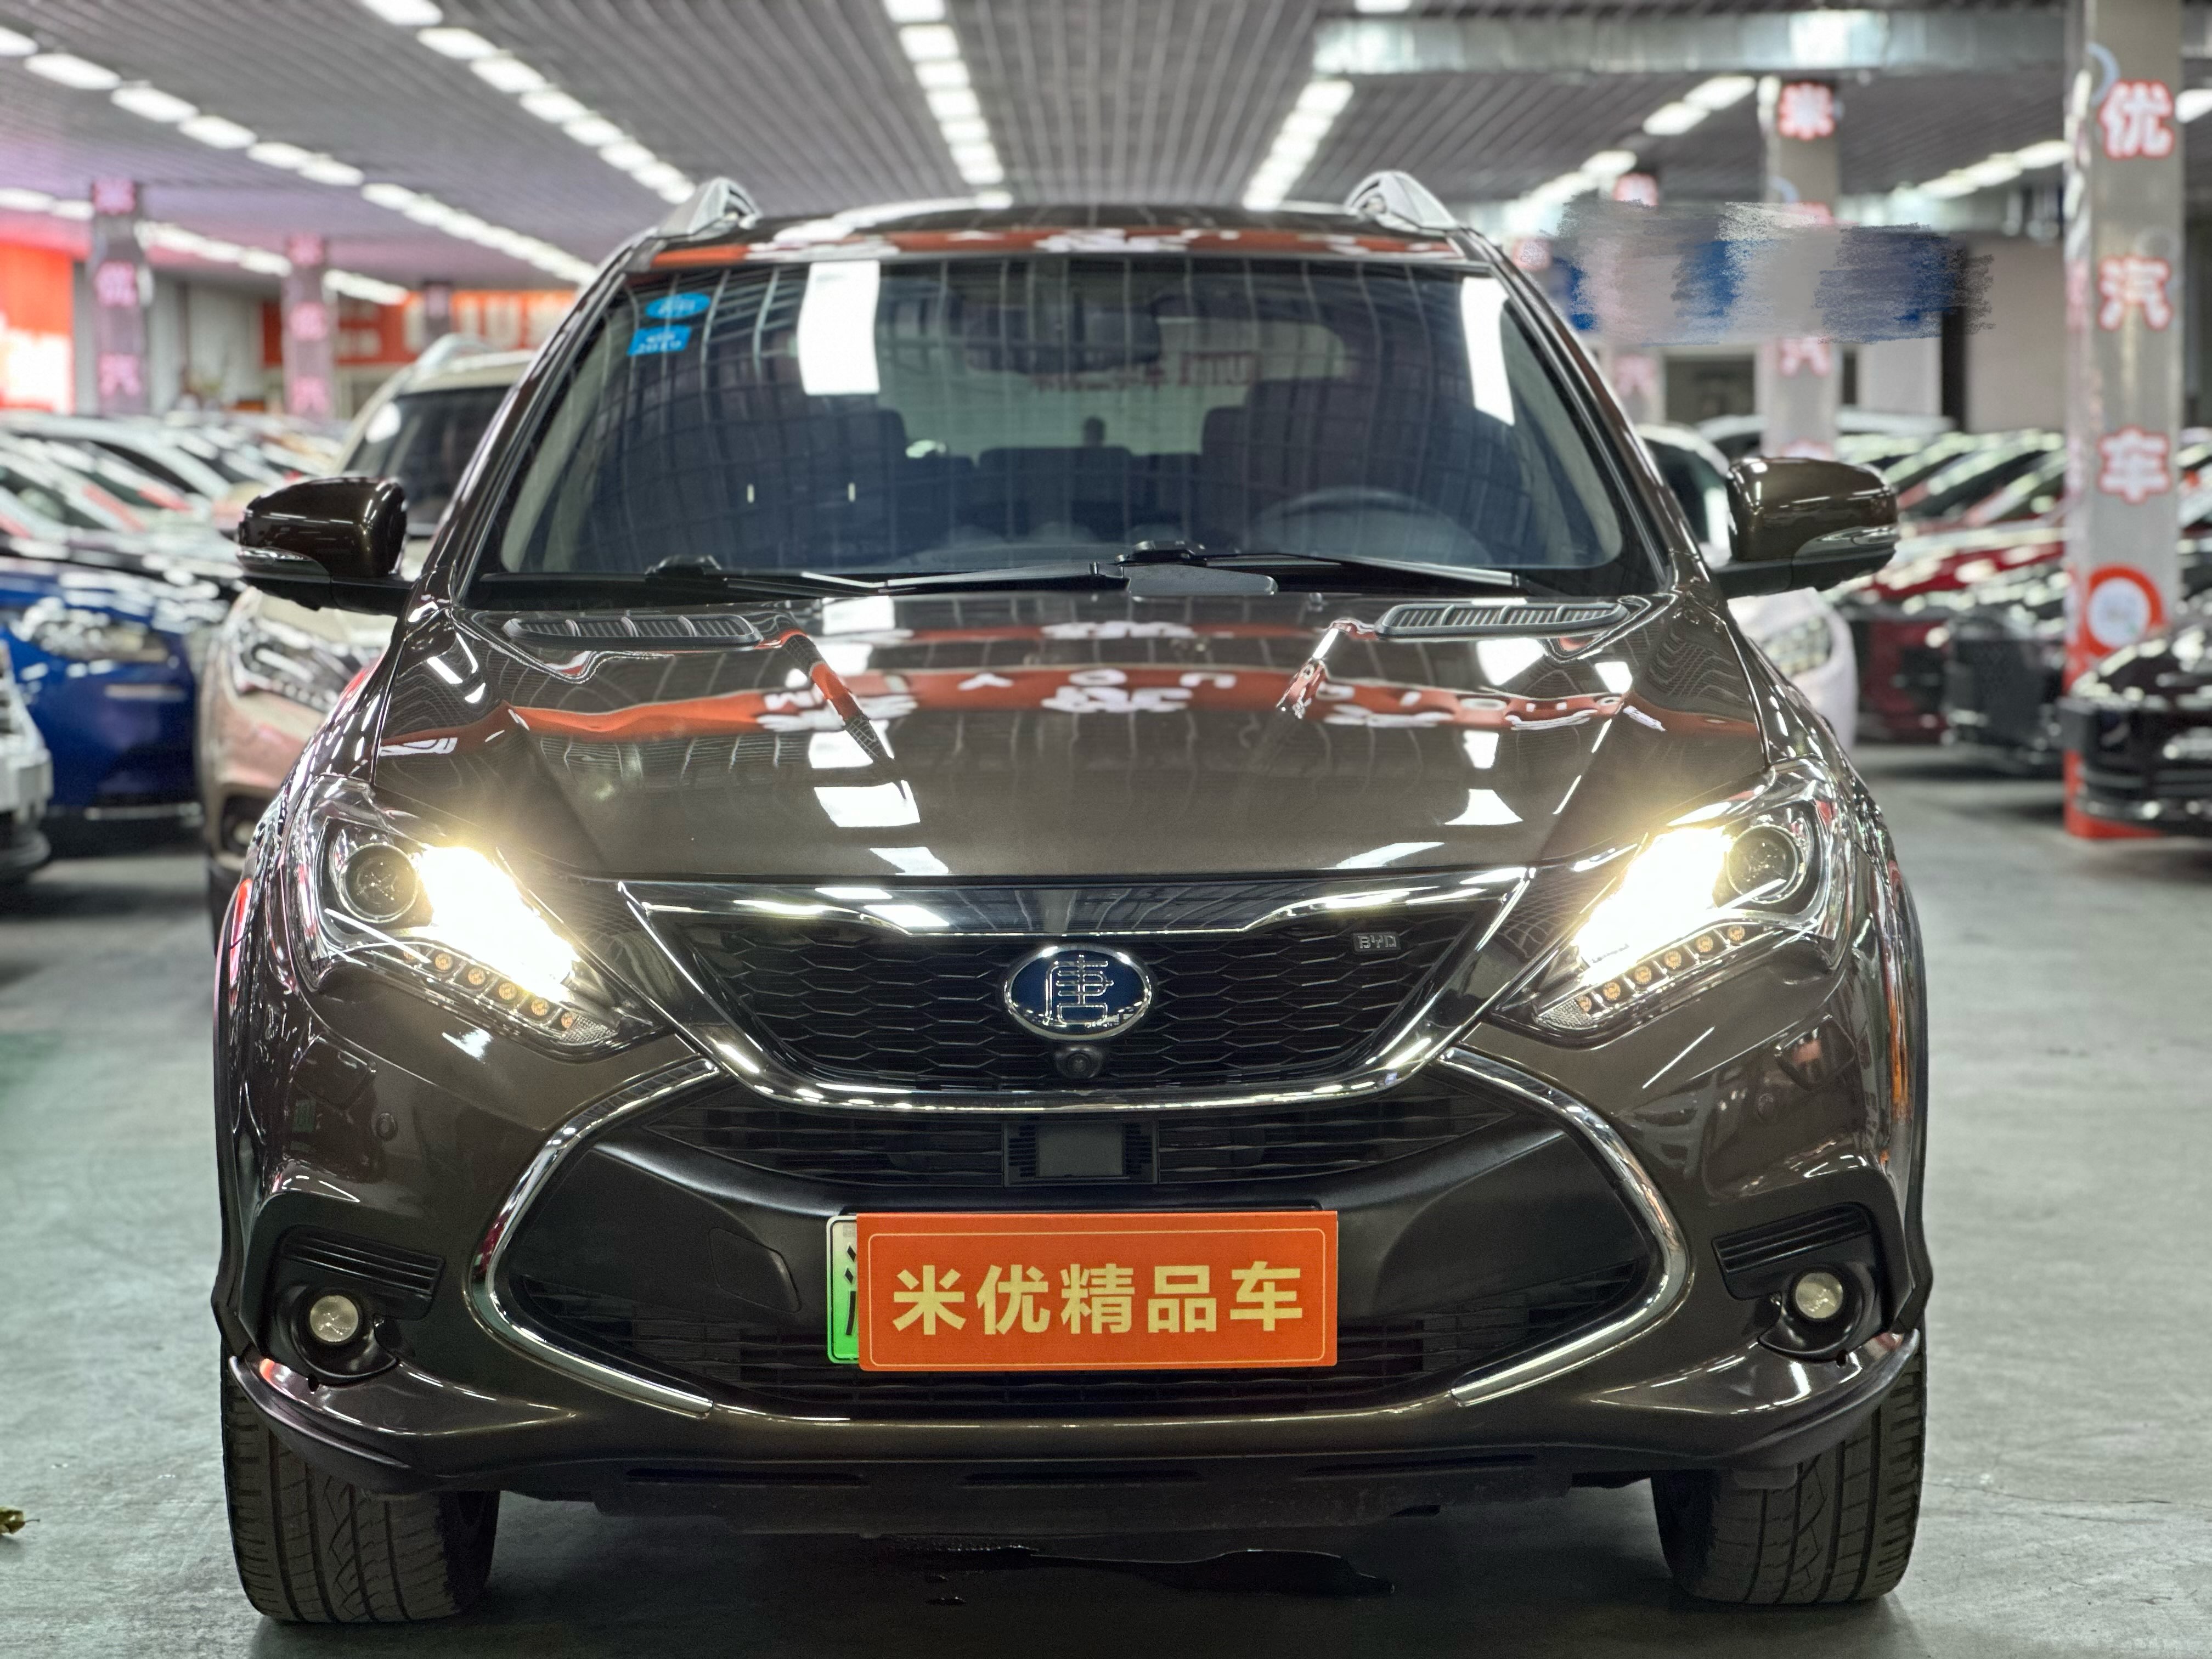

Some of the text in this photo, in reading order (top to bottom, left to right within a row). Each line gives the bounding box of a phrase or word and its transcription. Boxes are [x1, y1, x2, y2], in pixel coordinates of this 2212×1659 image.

[1357, 935, 1397, 949] BYD
[892, 1260, 1304, 1336] 米优精品车
